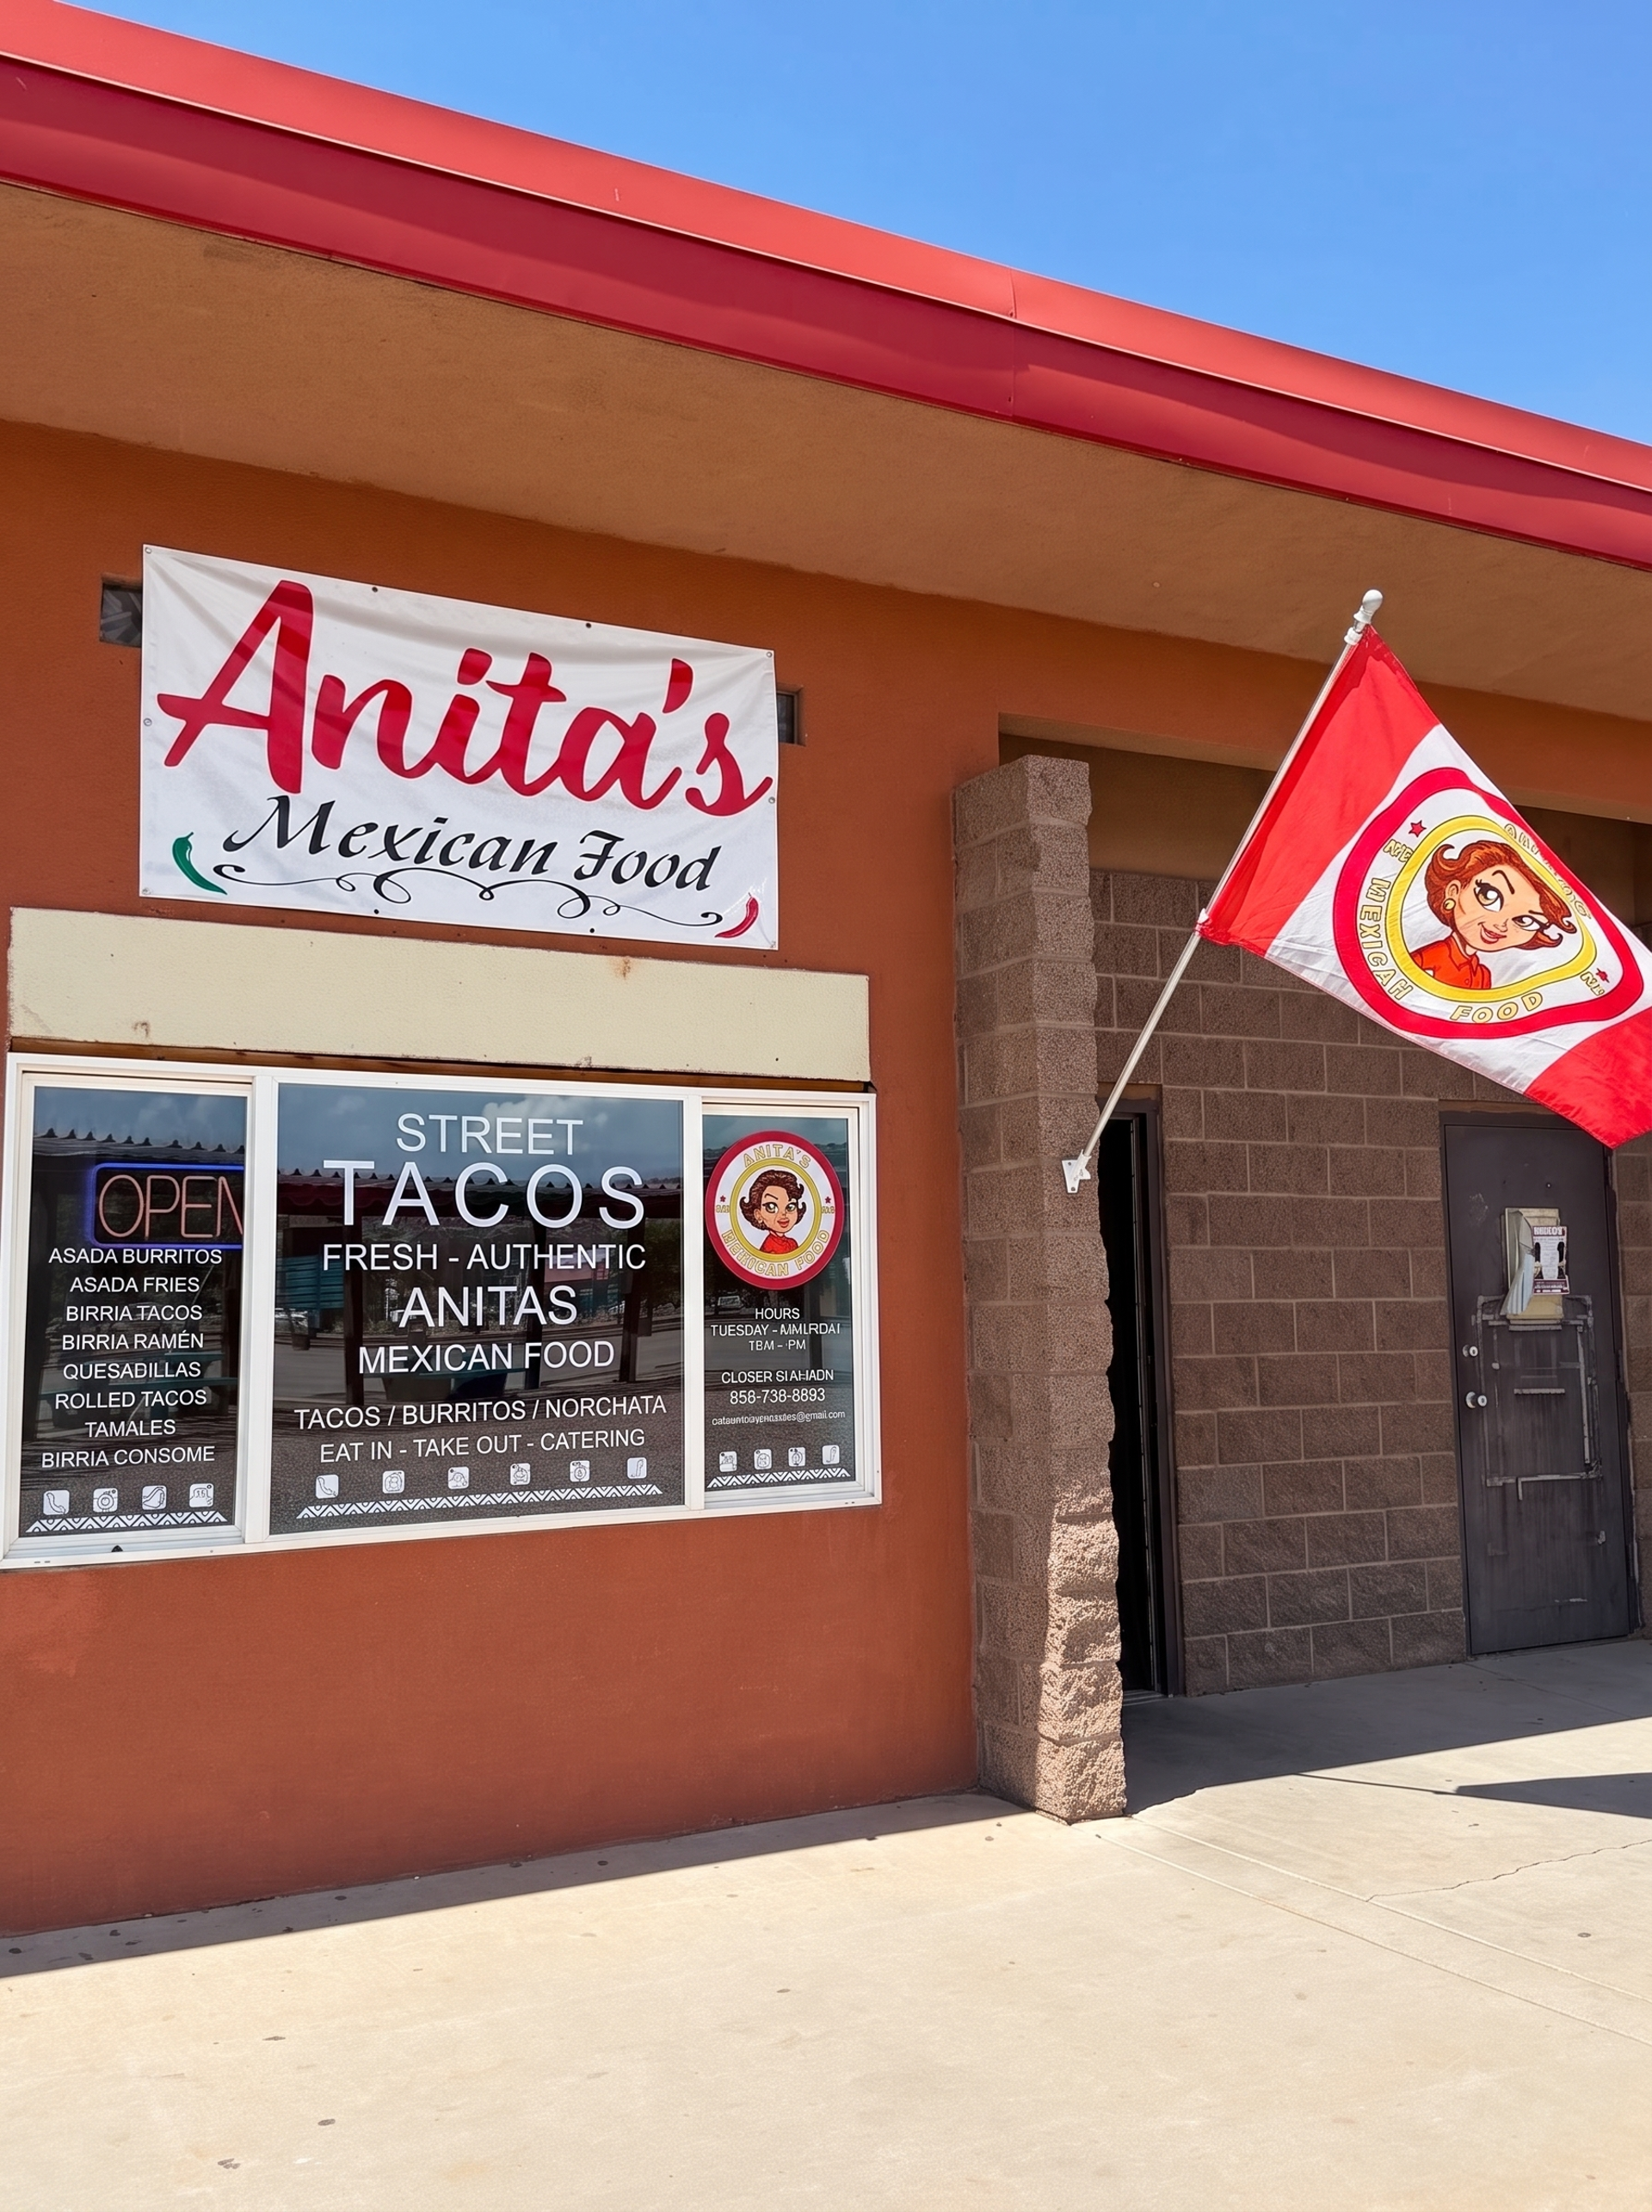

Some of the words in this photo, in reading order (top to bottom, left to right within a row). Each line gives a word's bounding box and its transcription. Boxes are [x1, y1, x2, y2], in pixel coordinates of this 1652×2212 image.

[156, 579, 774, 817] Anita's
[222, 794, 559, 876] Mexican
[572, 829, 722, 892] Food
[1450, 992, 1544, 1025] FOOD
[396, 1112, 583, 1156] STREET
[743, 1143, 811, 1168] ANITA'S
[322, 1159, 645, 1230] TACOS
[48, 1248, 118, 1264] ASADA
[122, 1248, 223, 1265] BURRITOS
[322, 1243, 439, 1272] FRESH
[466, 1242, 647, 1271] AUTHENTIC
[70, 1277, 139, 1293] ASADA
[143, 1276, 200, 1293] FRIES
[65, 1305, 133, 1322] BIRRIA
[136, 1304, 203, 1322] TACOS
[398, 1285, 578, 1328] ANITAS
[755, 1307, 800, 1320] HOURS
[62, 1334, 130, 1351] BIRRIA
[133, 1330, 205, 1349] RAMÉN
[710, 1323, 770, 1337] TUESDAY
[359, 1343, 514, 1375] MEXICAN
[524, 1340, 615, 1370] FOOD
[63, 1361, 202, 1380] QUESADILLAS
[721, 1370, 773, 1384] CLOSER
[54, 1391, 136, 1410] ROLLED
[140, 1389, 207, 1408] TACOS
[730, 1387, 826, 1405] 858-738-8893
[293, 1405, 381, 1431] TACOS
[403, 1400, 527, 1426] BURRITOS
[546, 1395, 668, 1420] NORCHATA
[84, 1419, 176, 1438] TAMALES
[41, 1450, 110, 1468] BIRRIA
[114, 1445, 216, 1466] CONSOME
[320, 1441, 364, 1463] EAT
[370, 1440, 393, 1461] IN
[413, 1437, 470, 1458] TAKE
[476, 1434, 521, 1456] OUT
[540, 1428, 646, 1453] CATERING
